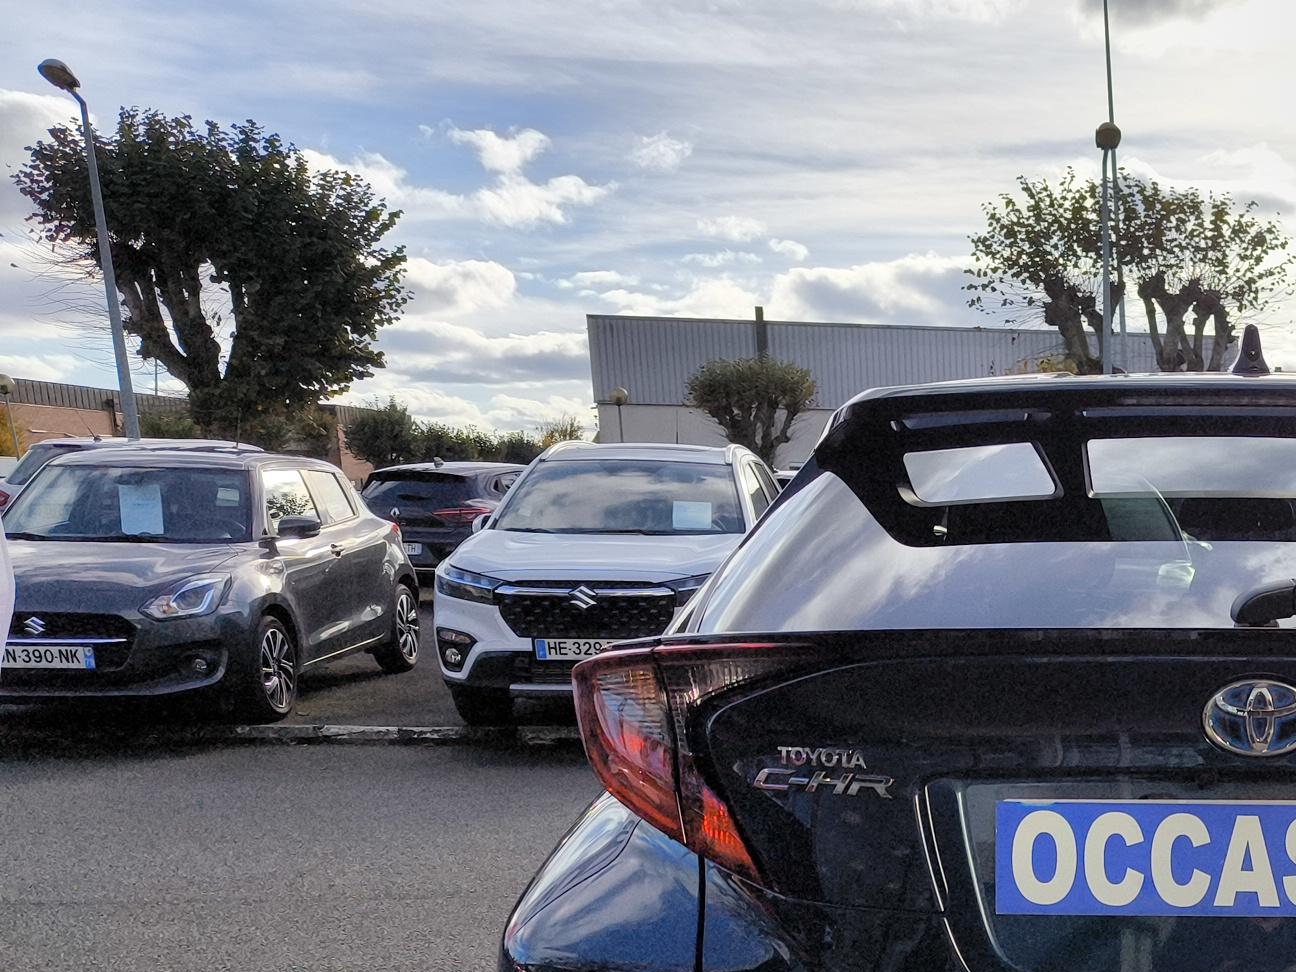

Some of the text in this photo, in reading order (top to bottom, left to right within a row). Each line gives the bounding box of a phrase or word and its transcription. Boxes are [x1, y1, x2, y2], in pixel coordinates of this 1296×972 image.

[1, 648, 81, 664] N-390-NK
[777, 746, 867, 769] TOYOTA
[753, 768, 895, 799] C-HR
